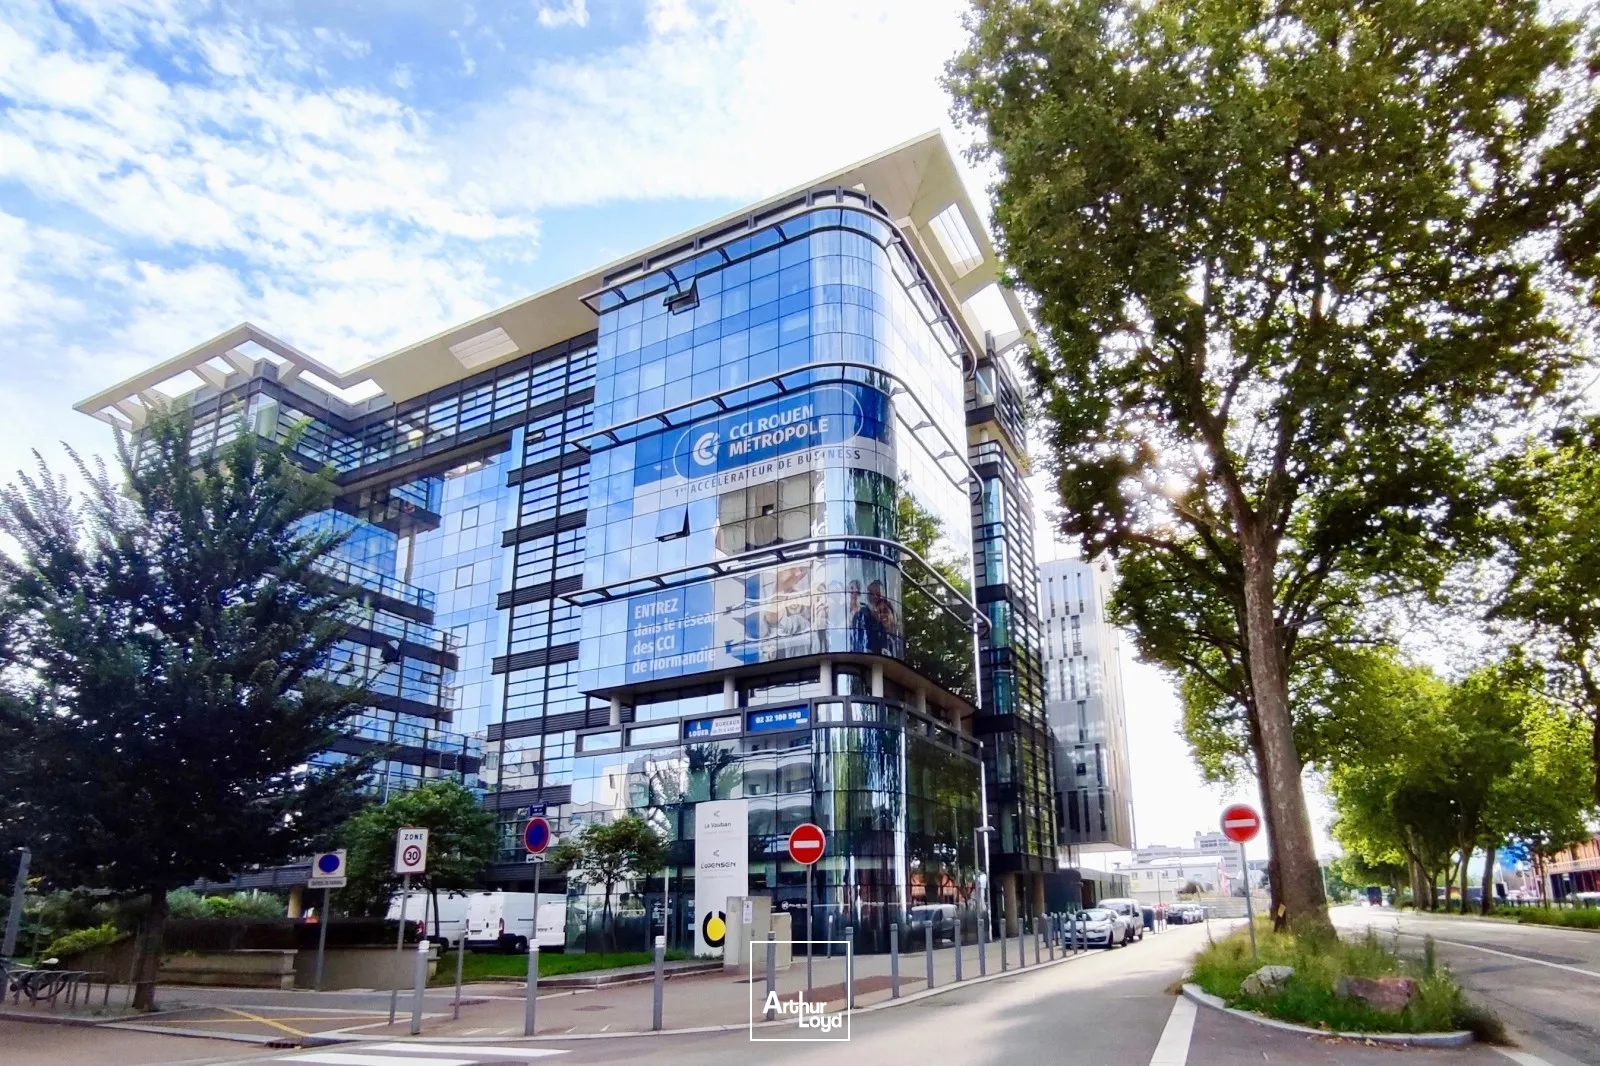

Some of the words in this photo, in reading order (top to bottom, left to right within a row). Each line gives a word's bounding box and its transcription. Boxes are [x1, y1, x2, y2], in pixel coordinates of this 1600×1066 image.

[729, 421, 752, 440] CCI
[758, 404, 813, 432] ROUEN
[778, 458, 792, 470] DE
[797, 449, 861, 465] BUSINESS
[634, 597, 679, 620] ENTREZ
[633, 623, 662, 637] dans
[664, 618, 675, 631] le
[677, 612, 719, 629] réseau
[633, 641, 654, 656] des
[656, 635, 675, 652] CCI
[632, 660, 648, 674] de
[688, 729, 709, 738] LOUER
[407, 851, 418, 861] 30
